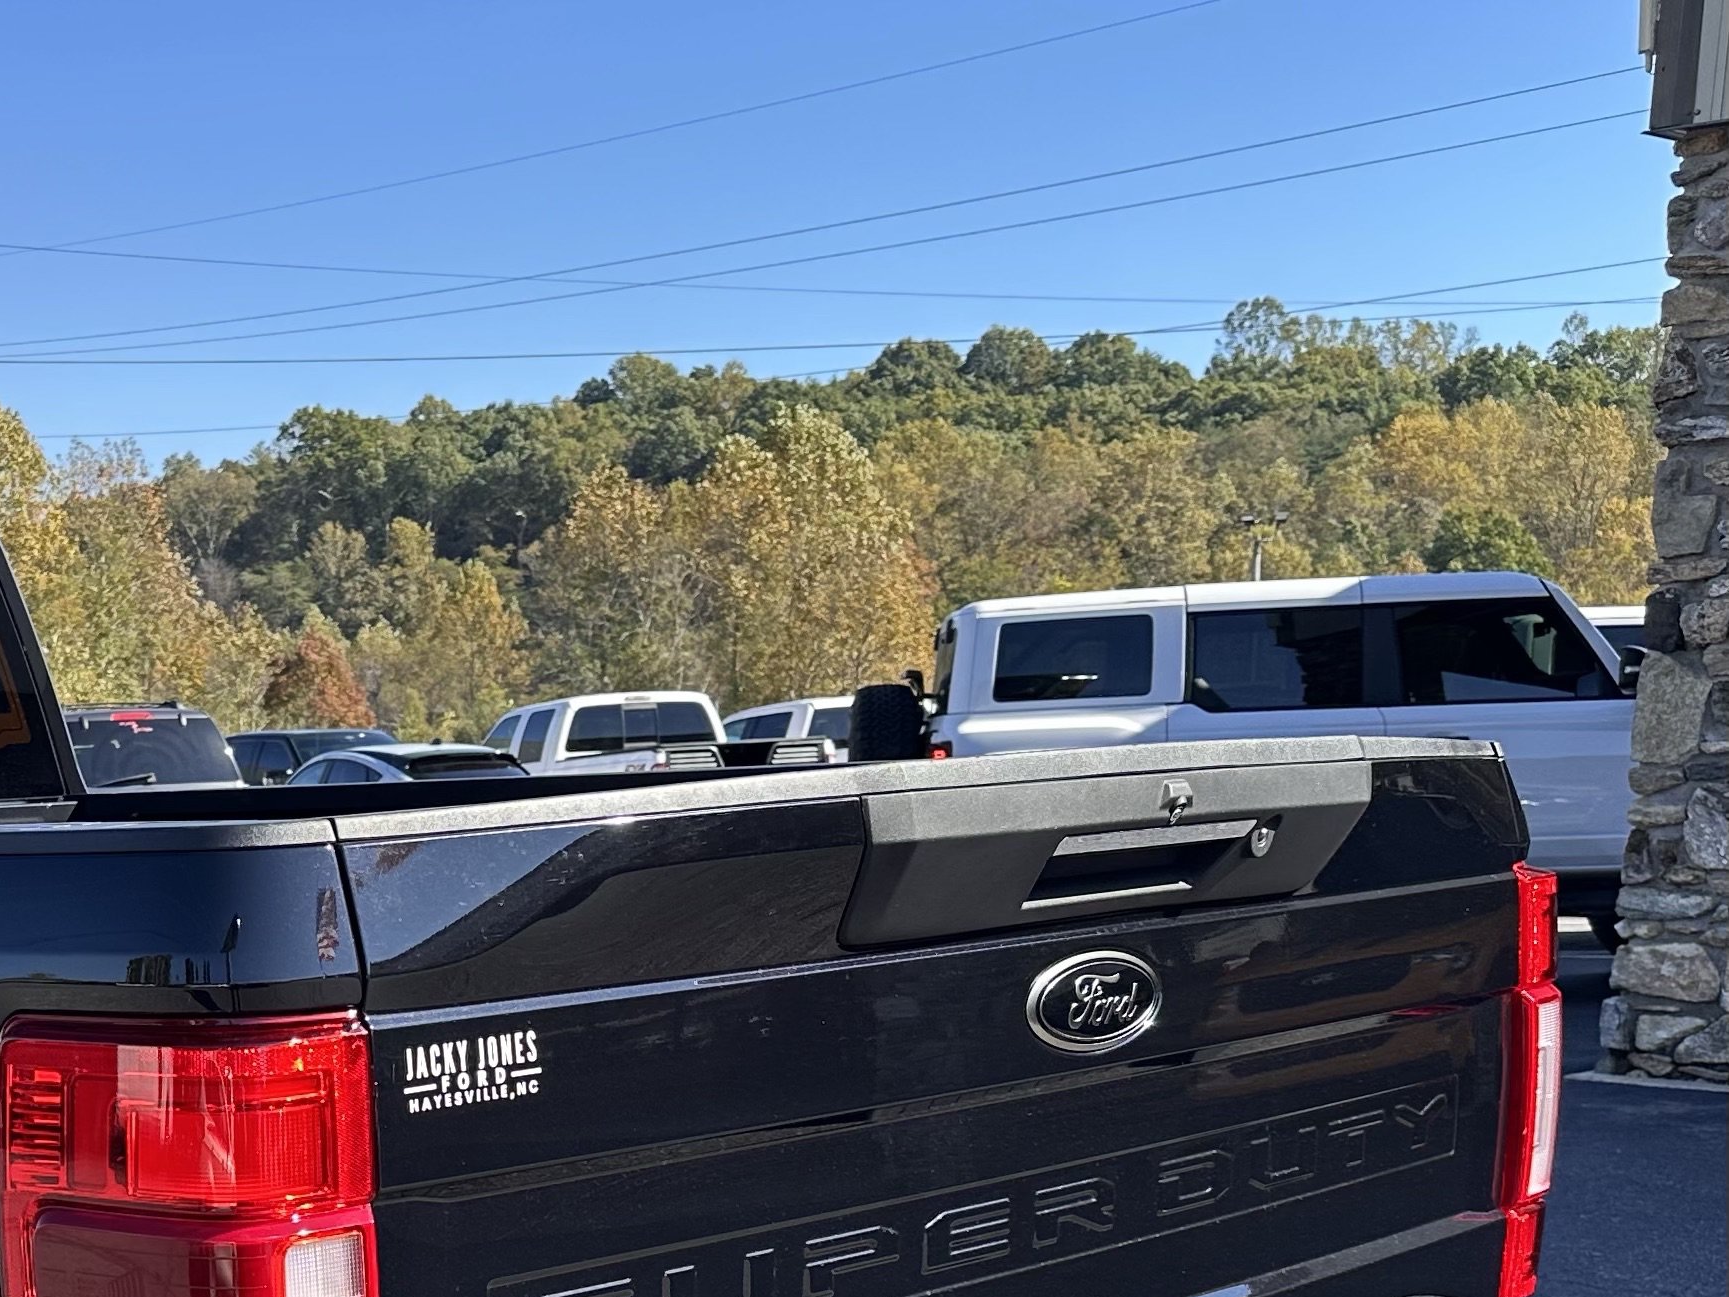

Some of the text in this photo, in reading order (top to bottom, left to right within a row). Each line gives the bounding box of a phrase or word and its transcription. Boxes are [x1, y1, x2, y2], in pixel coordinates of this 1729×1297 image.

[405, 1029, 538, 1081] JACKY JONES
[441, 1066, 507, 1093] FORD
[1156, 1092, 1449, 1217] DUTY
